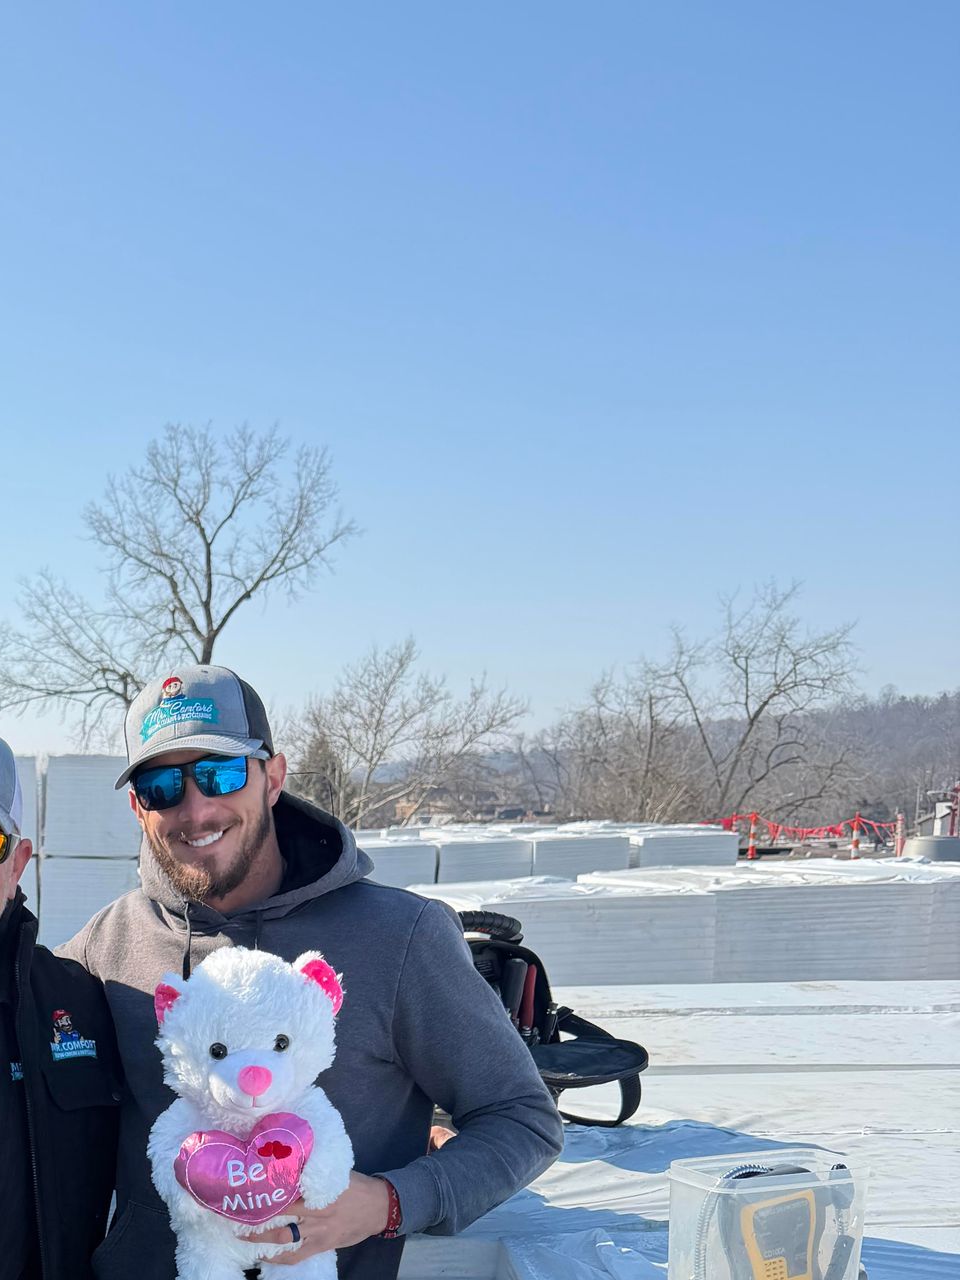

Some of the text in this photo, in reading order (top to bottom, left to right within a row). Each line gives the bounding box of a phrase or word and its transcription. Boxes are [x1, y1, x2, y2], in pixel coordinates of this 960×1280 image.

[169, 701, 213, 716] Comfort
[62, 1040, 95, 1051] COMFORT
[227, 1159, 267, 1187] Be
[223, 1188, 287, 1211] Mine
